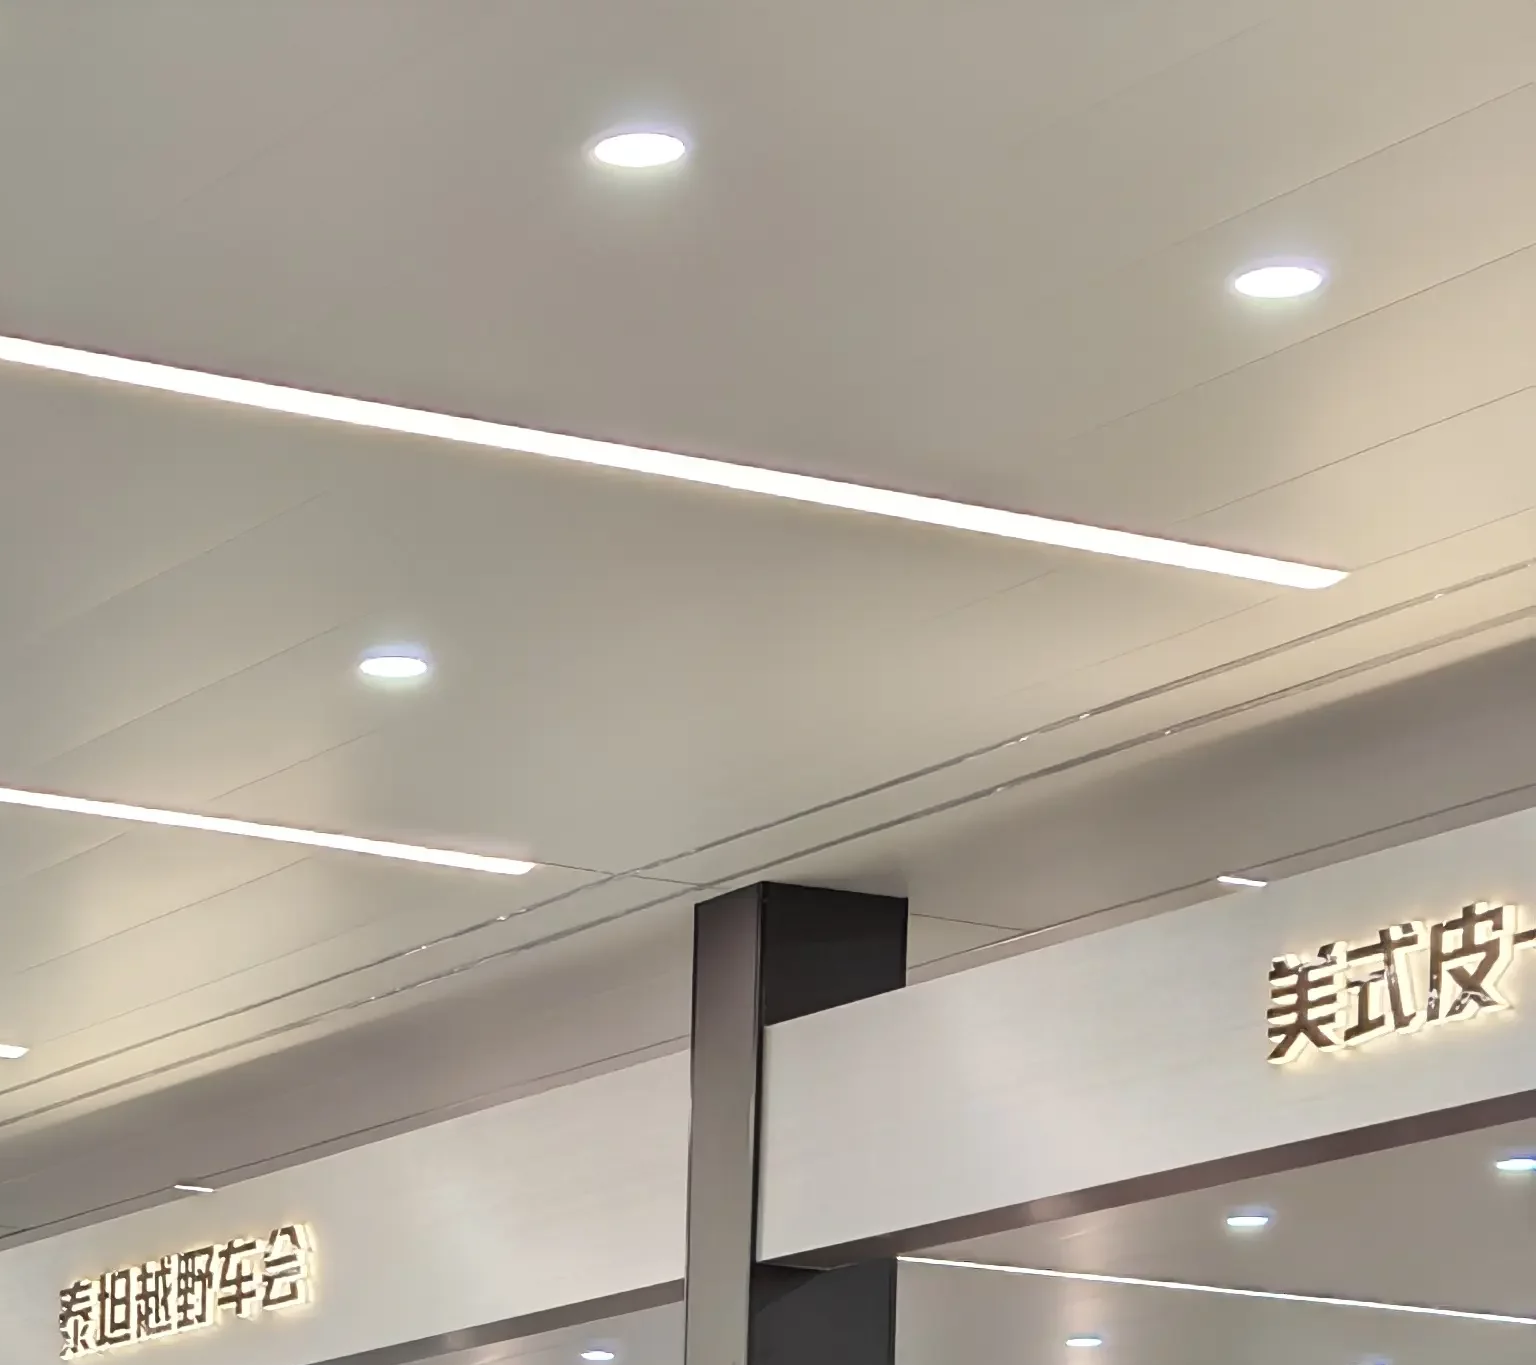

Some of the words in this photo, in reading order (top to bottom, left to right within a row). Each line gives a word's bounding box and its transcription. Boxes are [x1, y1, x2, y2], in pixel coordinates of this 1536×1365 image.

[59, 1224, 310, 1361] 泰坦越野车会
